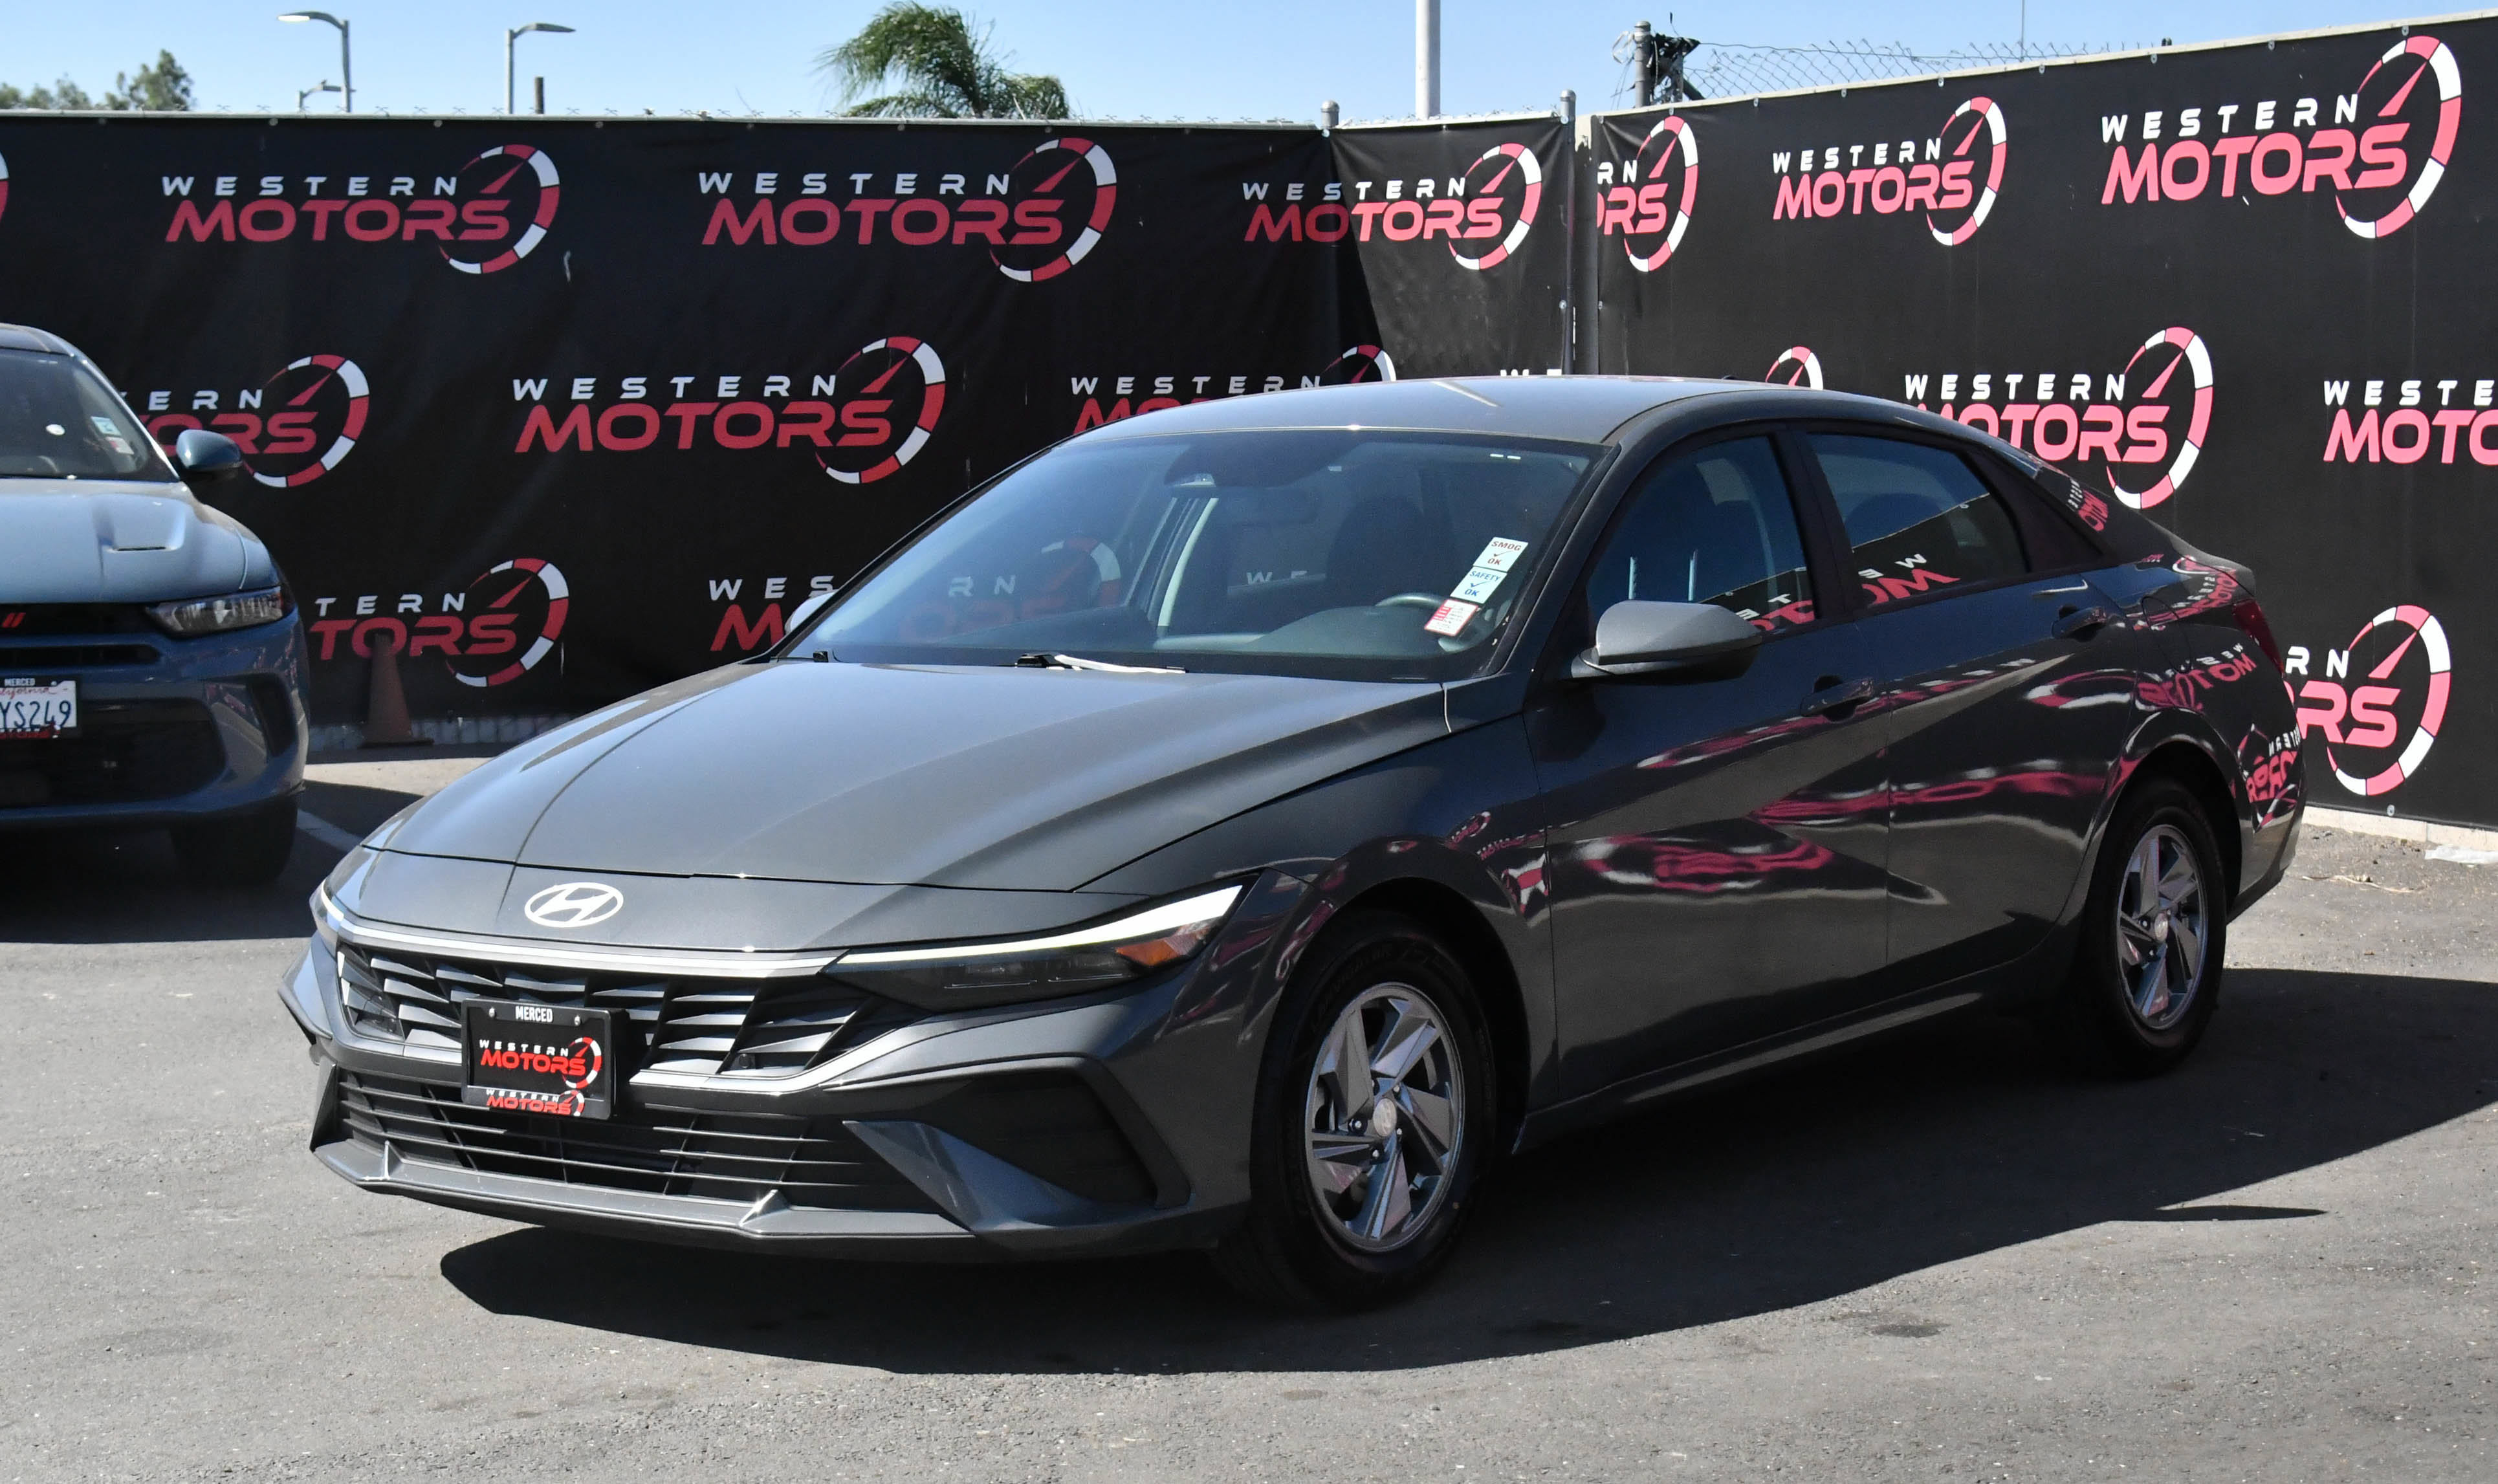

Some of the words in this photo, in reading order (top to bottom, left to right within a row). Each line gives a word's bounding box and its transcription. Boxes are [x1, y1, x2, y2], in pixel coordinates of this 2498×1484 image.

[2101, 93, 2358, 143] WESTERN
[1773, 137, 1941, 173] WESTERN
[2101, 122, 2411, 204] MOTORS
[162, 176, 457, 196] WESTERN
[699, 172, 1010, 195] WESTERN
[1243, 177, 1465, 201] WESTERN
[1773, 160, 1975, 220] MOTORS
[166, 199, 510, 242] MOTORS
[702, 198, 1064, 245] MOTORS
[1244, 197, 1504, 243] MOTORS
[512, 375, 836, 401] WESTERN
[1071, 375, 1320, 395] WESTERN
[1905, 373, 2125, 401] WESTERN
[2323, 380, 2495, 406] WESTE
[514, 400, 894, 452] MOTORS
[1918, 402, 2170, 463] OTORS
[2323, 408, 2498, 466] MOTO
[1491, 540, 1522, 551] SMOG
[1487, 557, 1502, 565] OK
[1469, 570, 1501, 582] SAFETY
[314, 592, 466, 617] TERN
[1464, 588, 1480, 597] OK
[309, 614, 519, 660] TORS
[0, 700, 71, 730] YS249
[515, 1005, 553, 1023] MERCED
[479, 1039, 569, 1057] WESTERN
[480, 1048, 586, 1076] MOTORS
[486, 1089, 560, 1103] WESTERN
[486, 1095, 573, 1116] MOTORS
